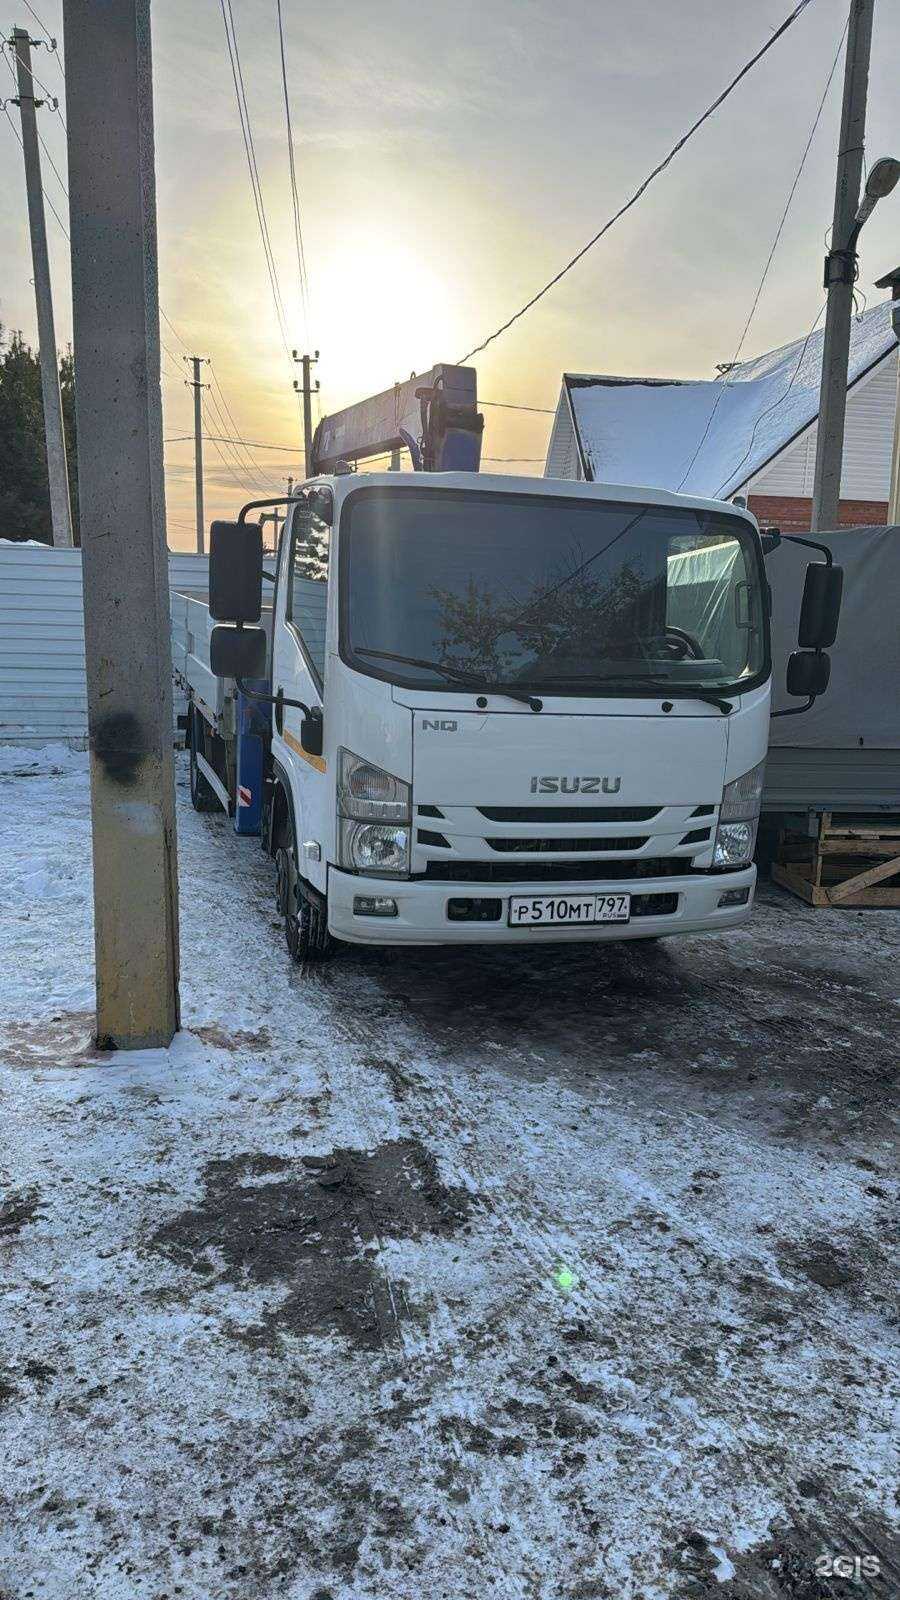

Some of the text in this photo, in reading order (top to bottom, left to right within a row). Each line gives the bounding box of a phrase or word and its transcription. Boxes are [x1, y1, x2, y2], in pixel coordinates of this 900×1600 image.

[422, 719, 458, 732] NQ
[530, 776, 622, 794] ISUZU
[597, 897, 626, 913] 797
